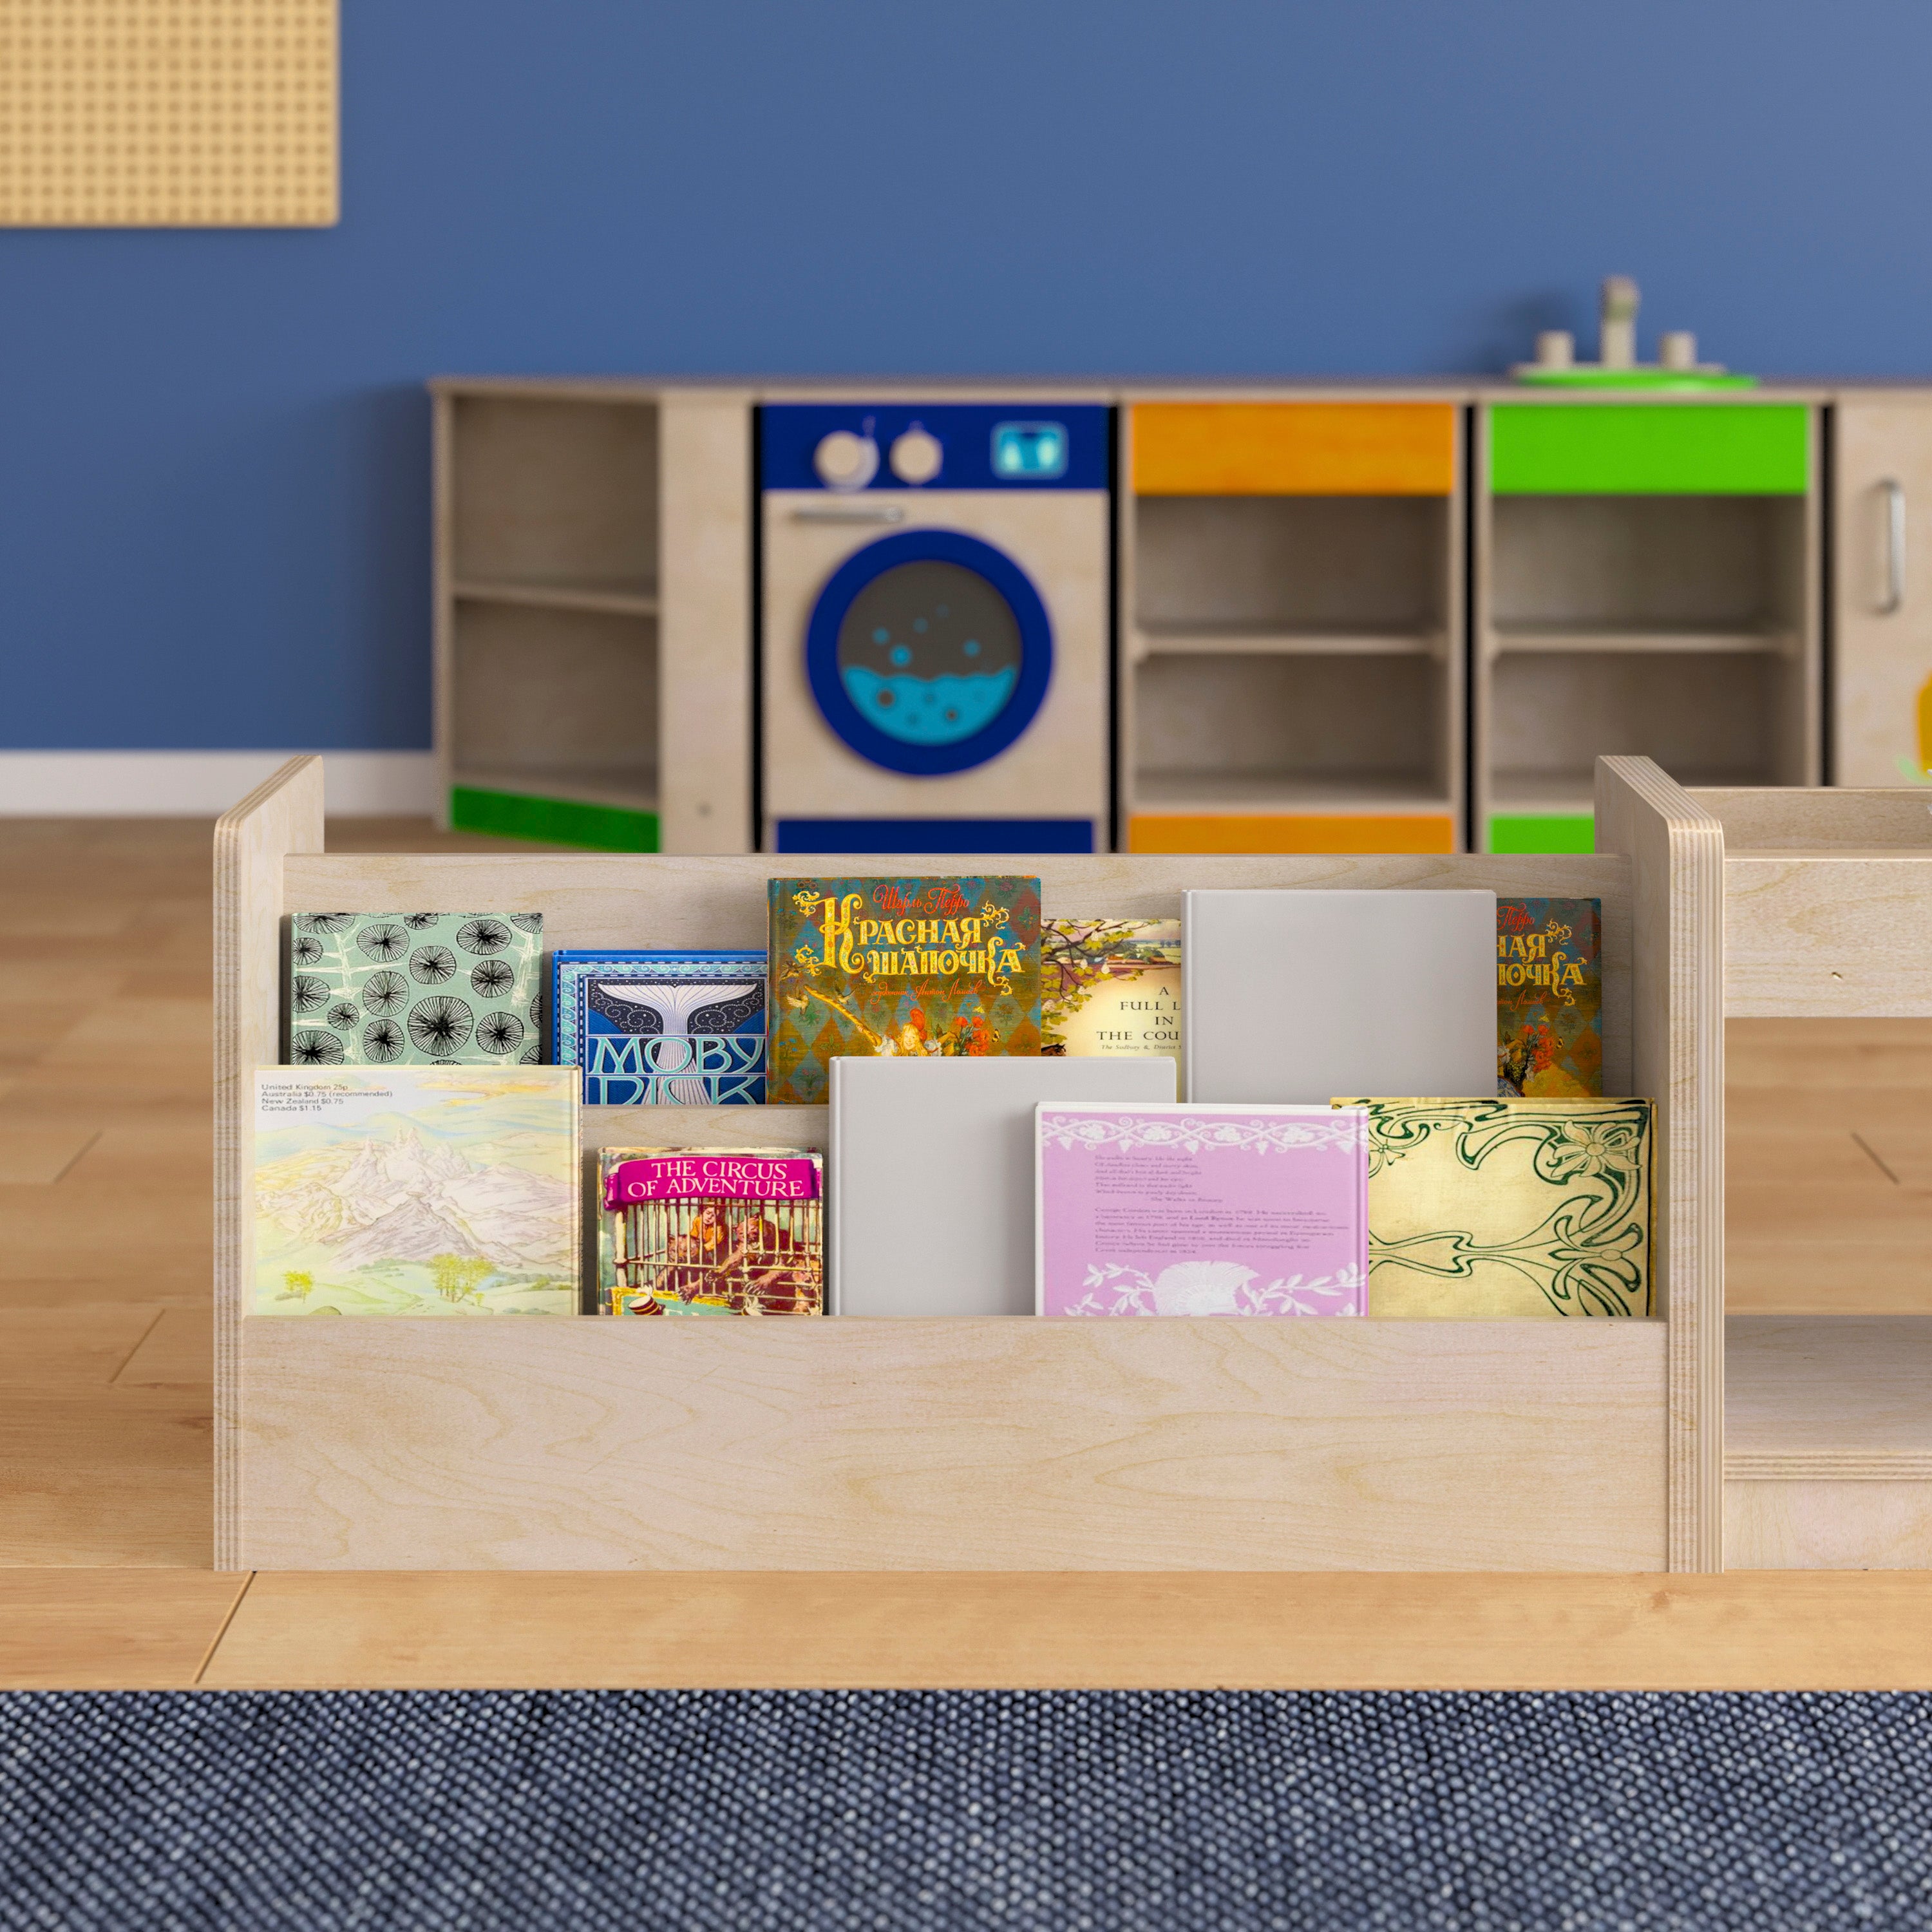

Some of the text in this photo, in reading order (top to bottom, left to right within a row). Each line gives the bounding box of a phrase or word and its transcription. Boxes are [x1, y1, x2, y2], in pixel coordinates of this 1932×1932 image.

[873, 884, 969, 916] Шарль Перро
[805, 893, 992, 974] КРАСНАЯ
[865, 936, 1025, 986] ШАПОЧКА
[1159, 987, 1170, 996] A
[1120, 1001, 1164, 1010] FULL
[1155, 1016, 1173, 1025] IN
[1096, 1031, 1179, 1041] THE COU
[588, 1037, 764, 1074] MOBY
[591, 1076, 761, 1104] DICK
[651, 1160, 788, 1180] THE CIRCUS
[627, 1178, 804, 1197] OF ADVENTURE
